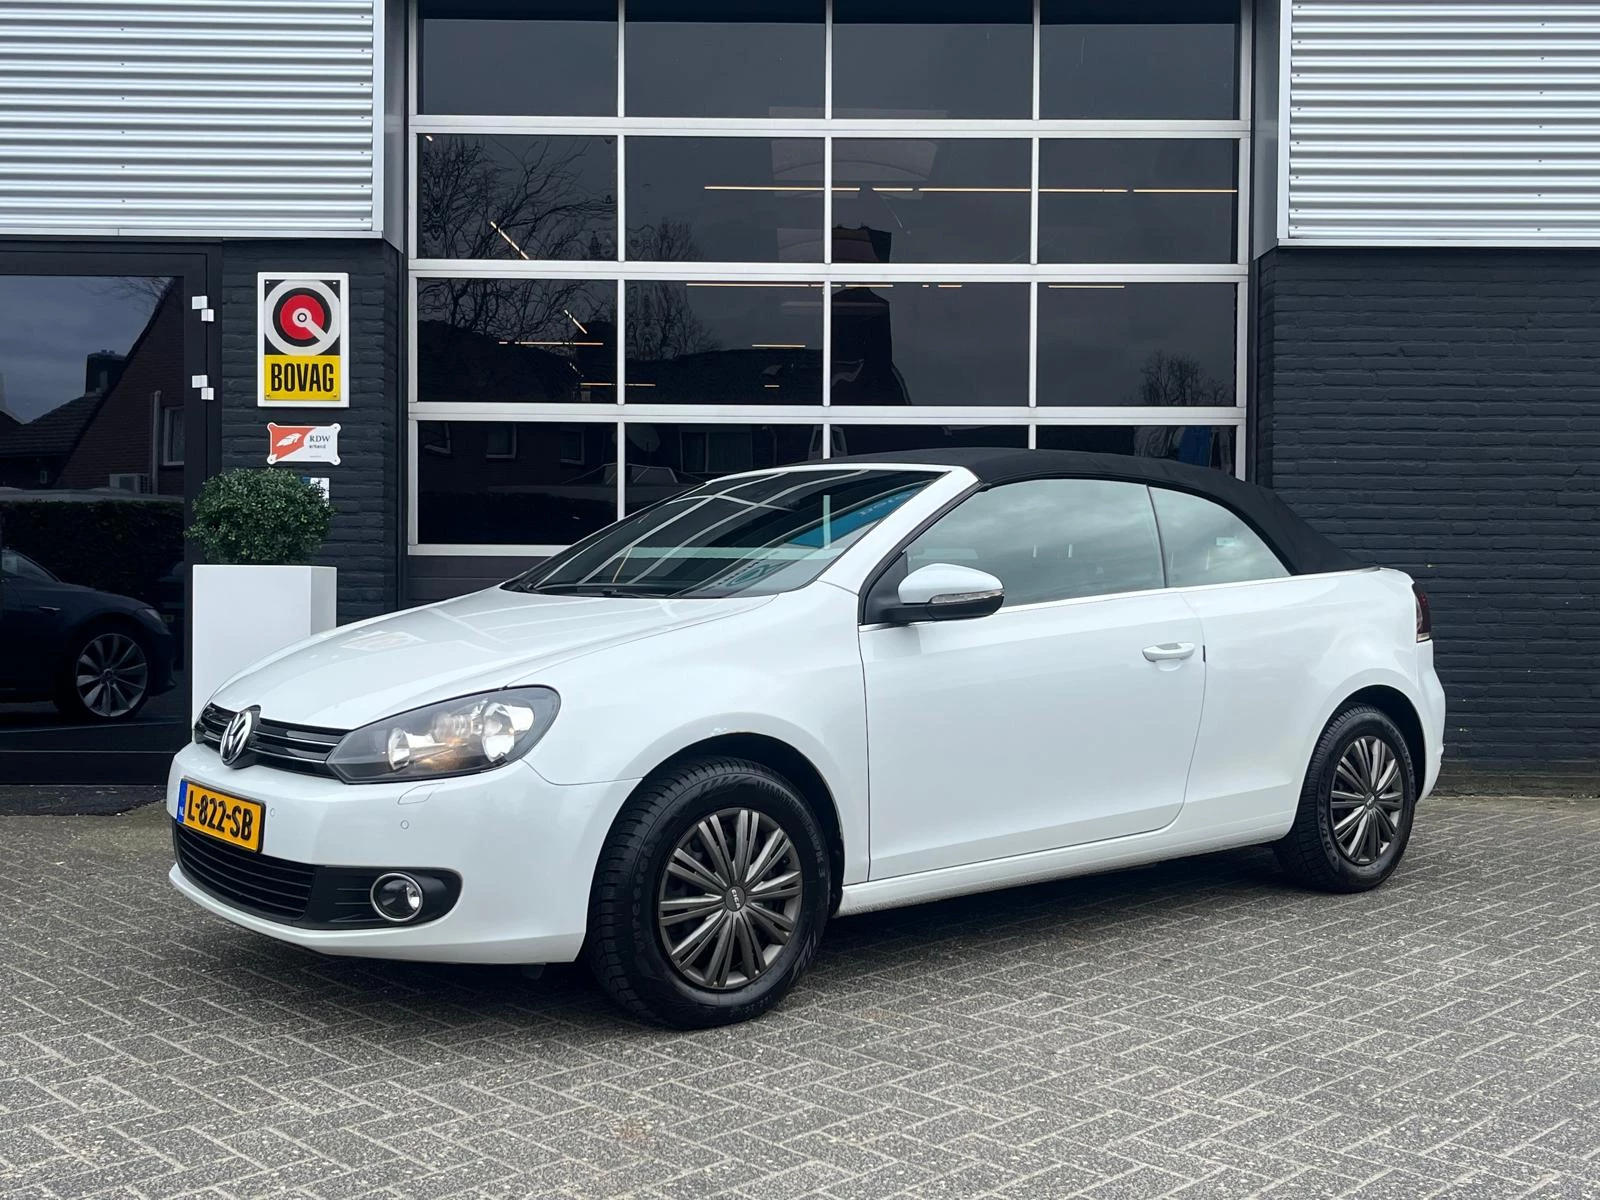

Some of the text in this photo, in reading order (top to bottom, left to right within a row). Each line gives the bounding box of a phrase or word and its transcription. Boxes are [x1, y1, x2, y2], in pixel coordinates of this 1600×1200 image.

[271, 363, 334, 392] BOVAG
[309, 434, 330, 443] RDW
[187, 790, 253, 841] L-822-SB
